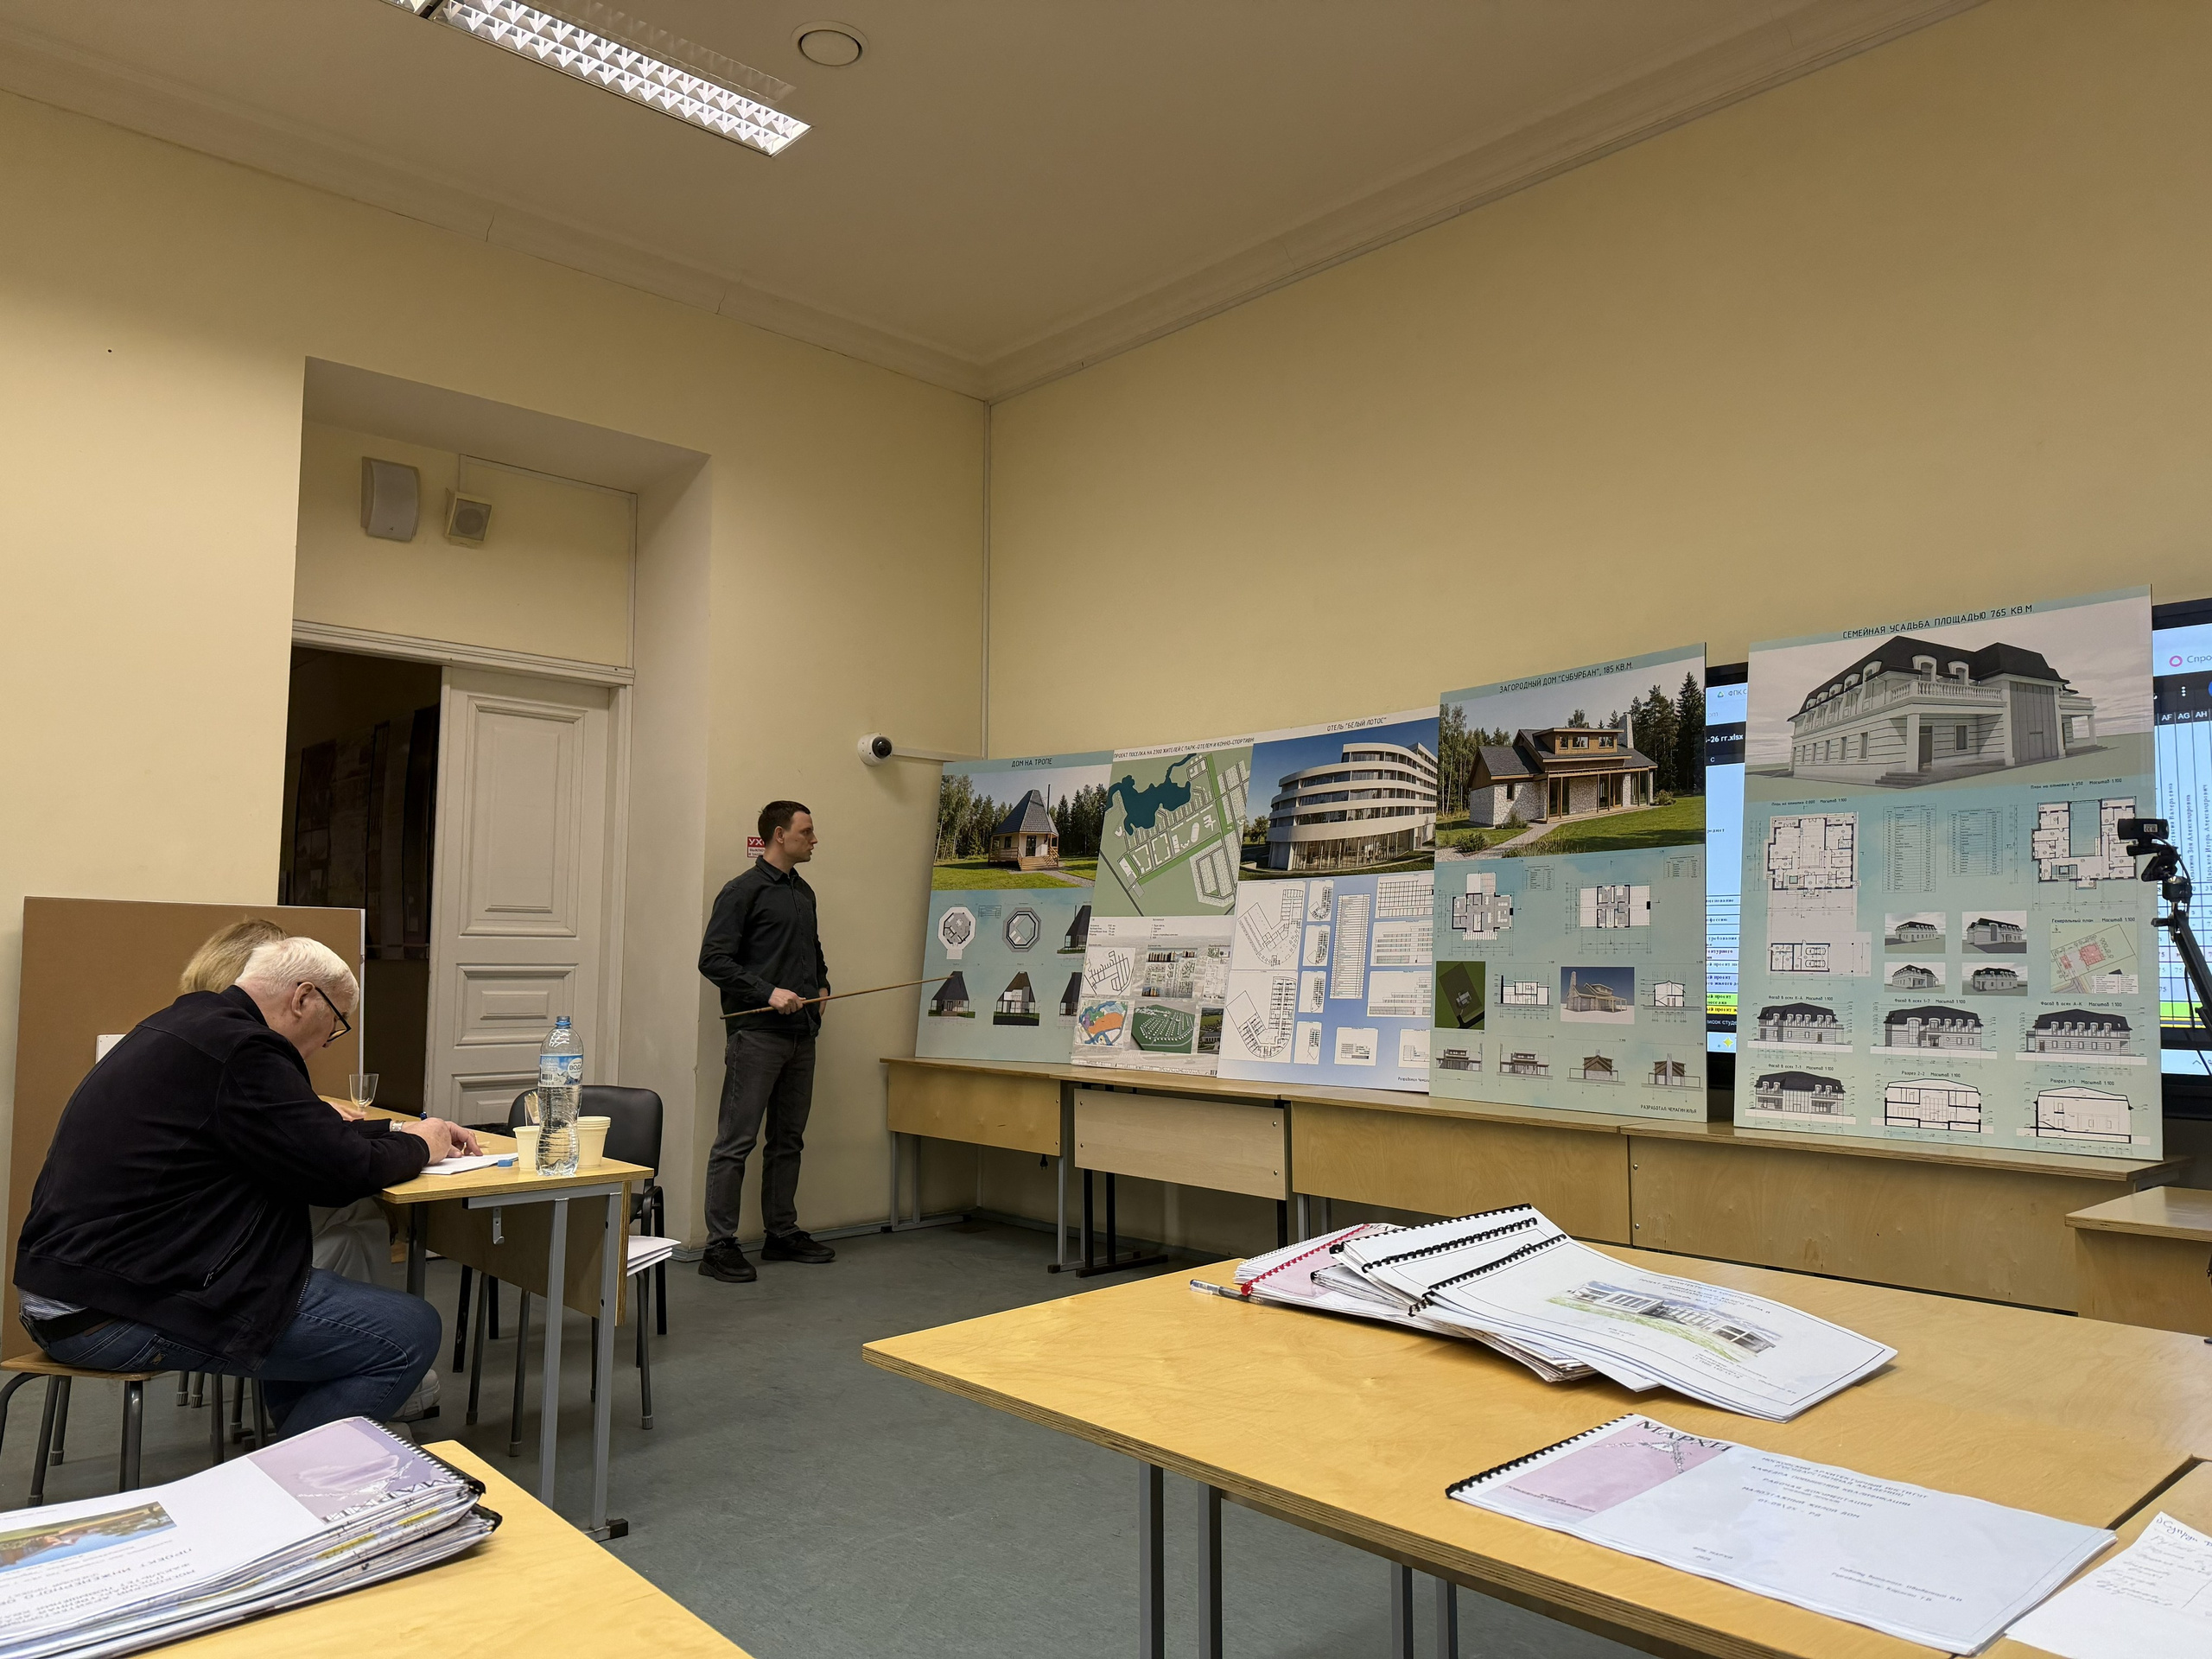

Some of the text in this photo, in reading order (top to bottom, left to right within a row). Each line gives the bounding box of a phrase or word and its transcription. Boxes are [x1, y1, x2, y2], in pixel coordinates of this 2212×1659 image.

[1842, 626, 1886, 639] СЕМЕЙНАЯ
[1890, 620, 1930, 632] УСАДЬБА
[1934, 611, 1986, 626] ПЛОЩАДЬЮ
[1990, 608, 2006, 618] 765
[1499, 678, 1541, 694] ЗАГОРОДНЫЙ
[1542, 676, 1557, 686] ДОМ
[1604, 664, 1614, 674] 185
[1637, 1420, 1733, 1452] МАРХИ
[140, 1548, 193, 1568] ПРОЕКТ
